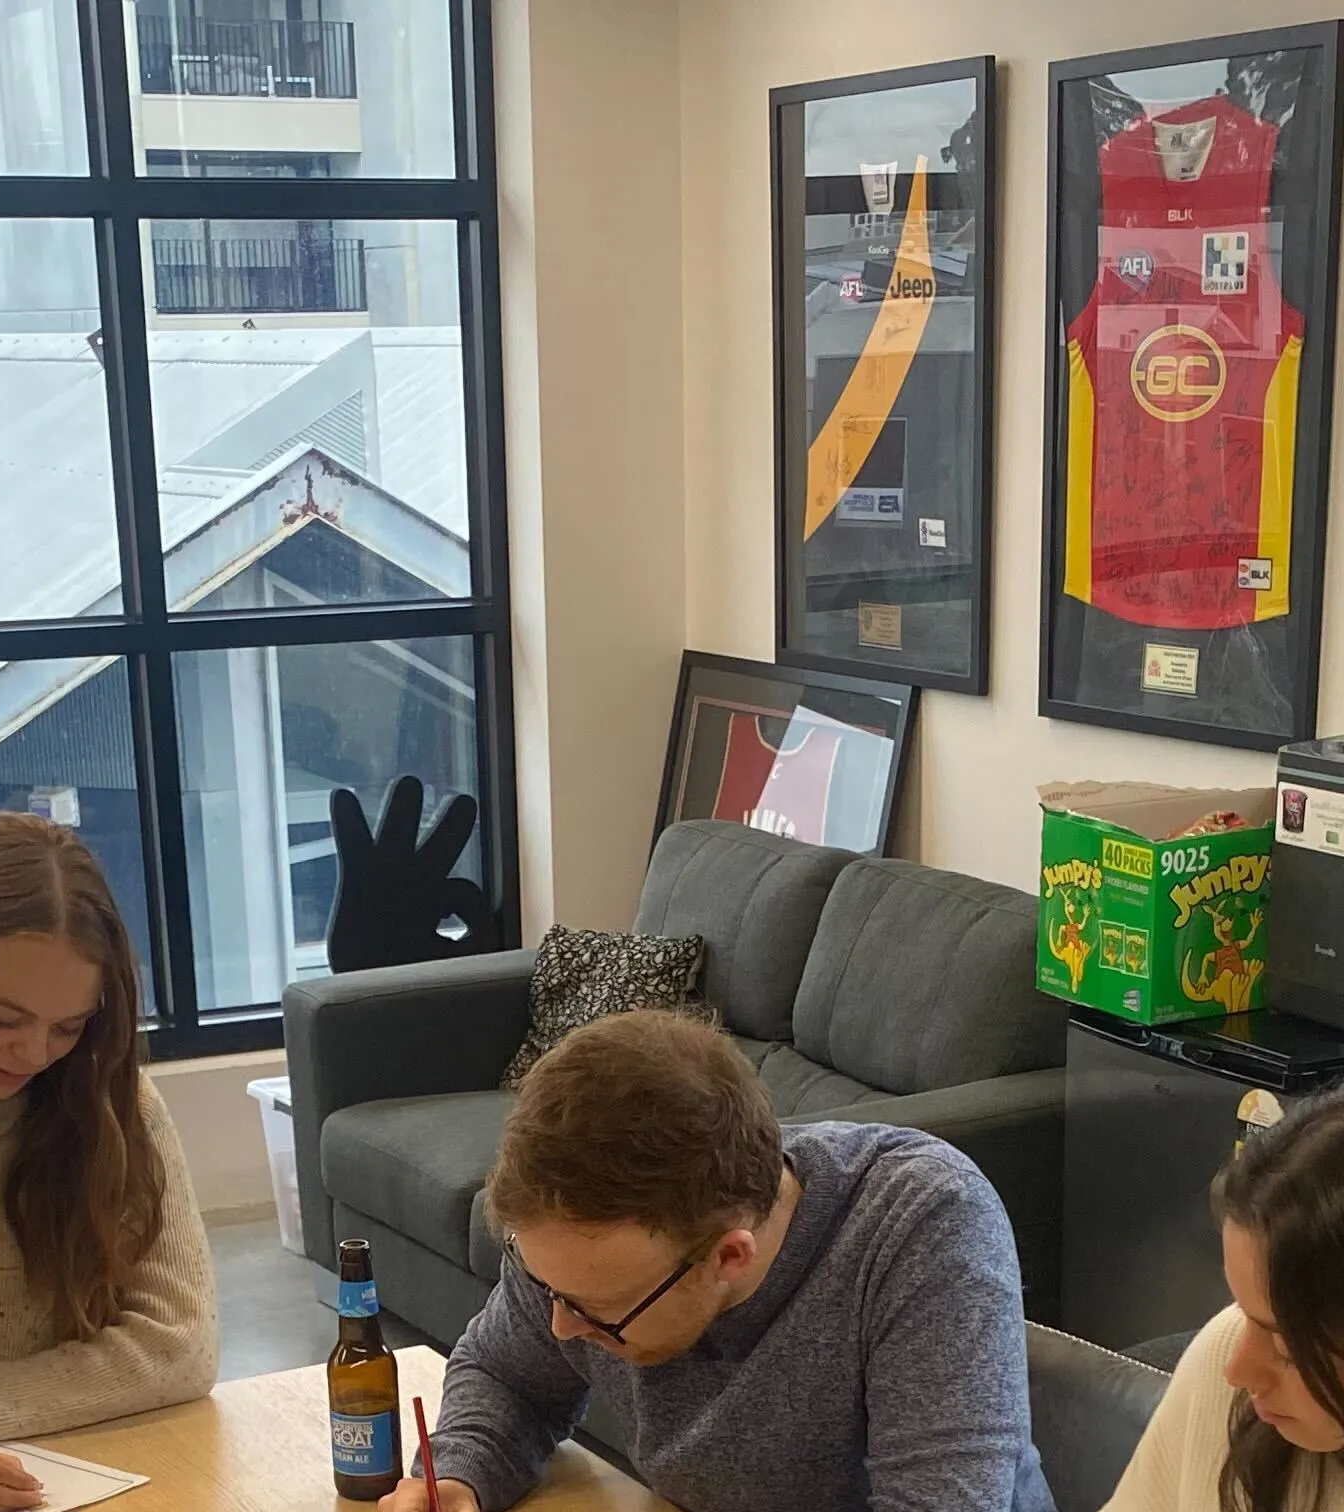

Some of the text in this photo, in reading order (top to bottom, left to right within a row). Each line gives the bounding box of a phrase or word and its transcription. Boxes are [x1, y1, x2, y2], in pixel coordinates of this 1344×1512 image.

[1167, 208, 1193, 222] BLK
[1120, 257, 1152, 276] AFL
[839, 280, 864, 297] AFL
[890, 271, 933, 304] Jeep
[1146, 355, 1219, 396] GC
[1251, 569, 1270, 580] BLK
[1105, 842, 1123, 868] 40
[1123, 854, 1152, 876] PACKS
[1160, 845, 1210, 877] 9025
[335, 1430, 373, 1447] GOAT
[355, 1454, 370, 1464] ALE
